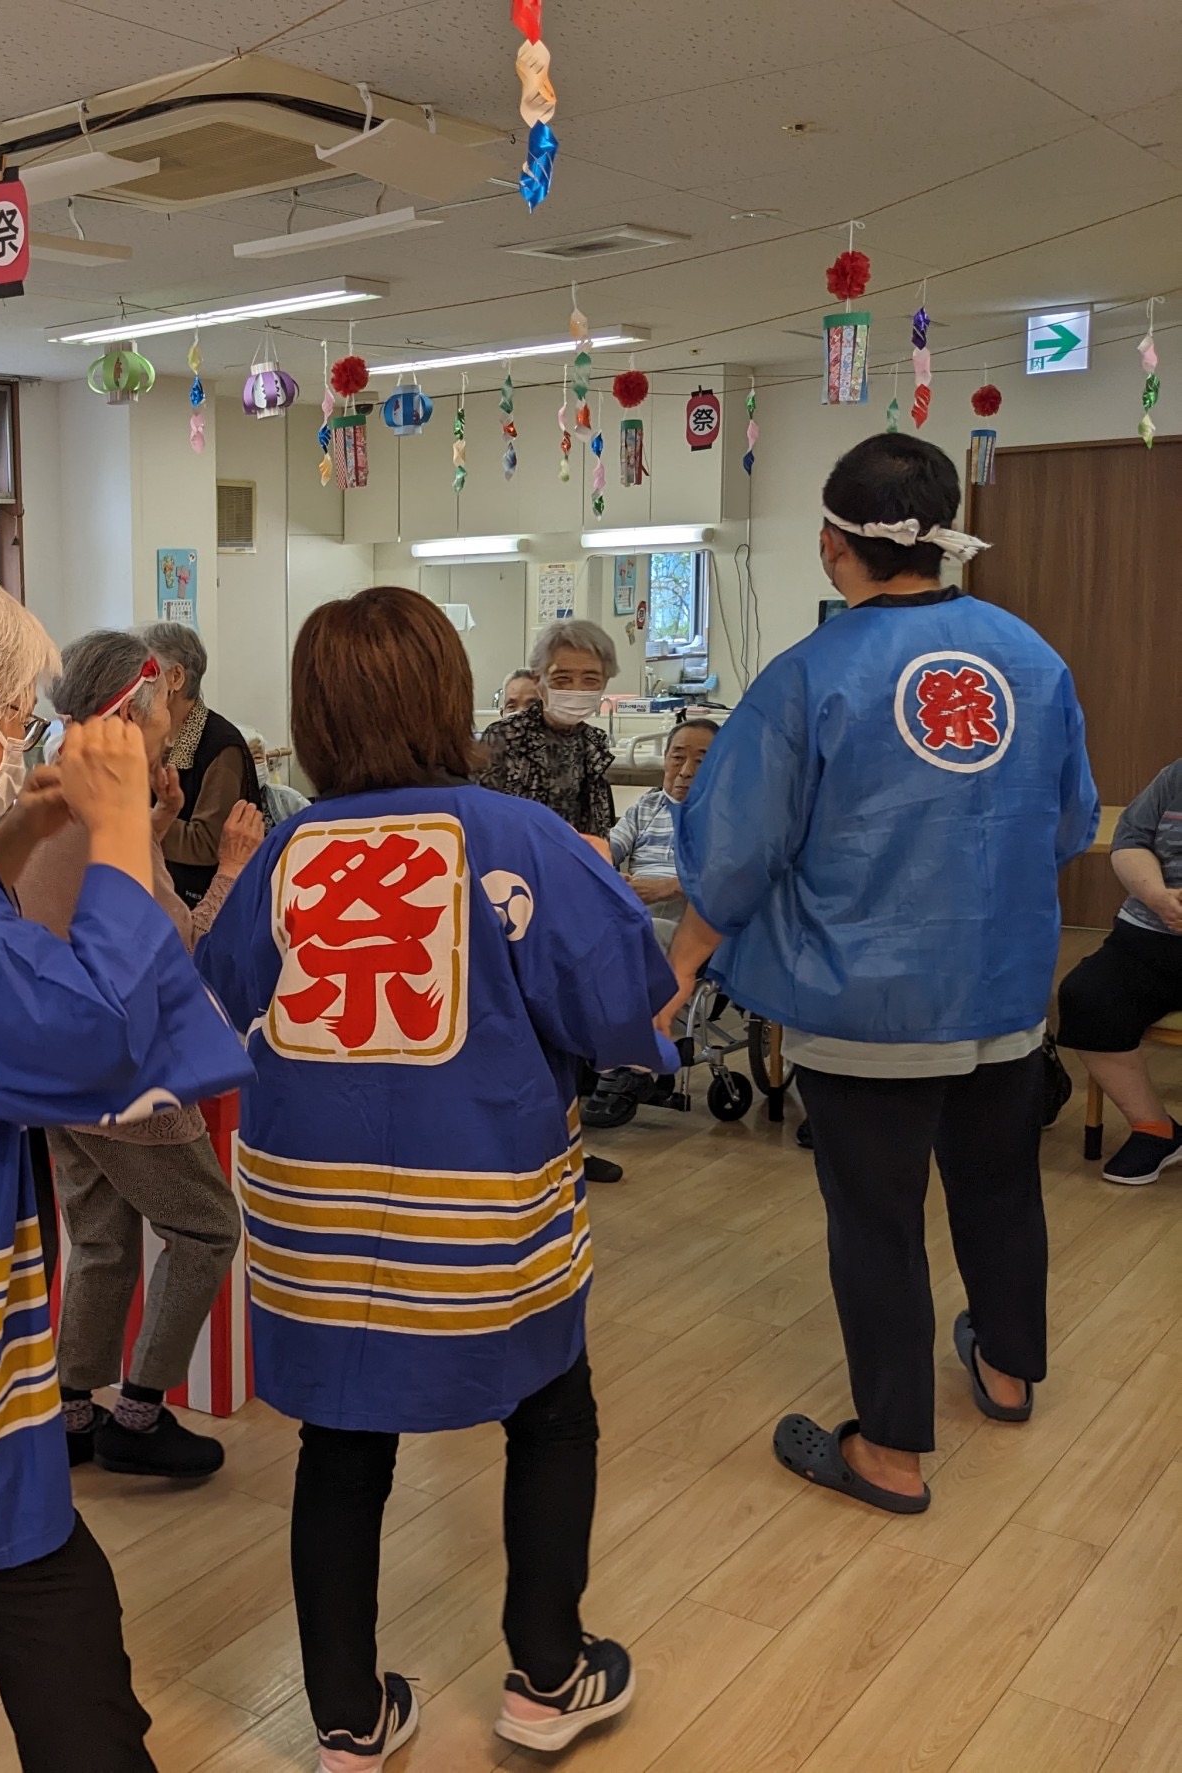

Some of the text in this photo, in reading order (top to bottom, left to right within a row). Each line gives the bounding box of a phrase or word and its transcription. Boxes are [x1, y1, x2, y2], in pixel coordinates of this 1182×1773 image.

[693, 408, 714, 431] 祭
[916, 667, 1000, 750] 祭
[277, 833, 449, 1049] 祭
